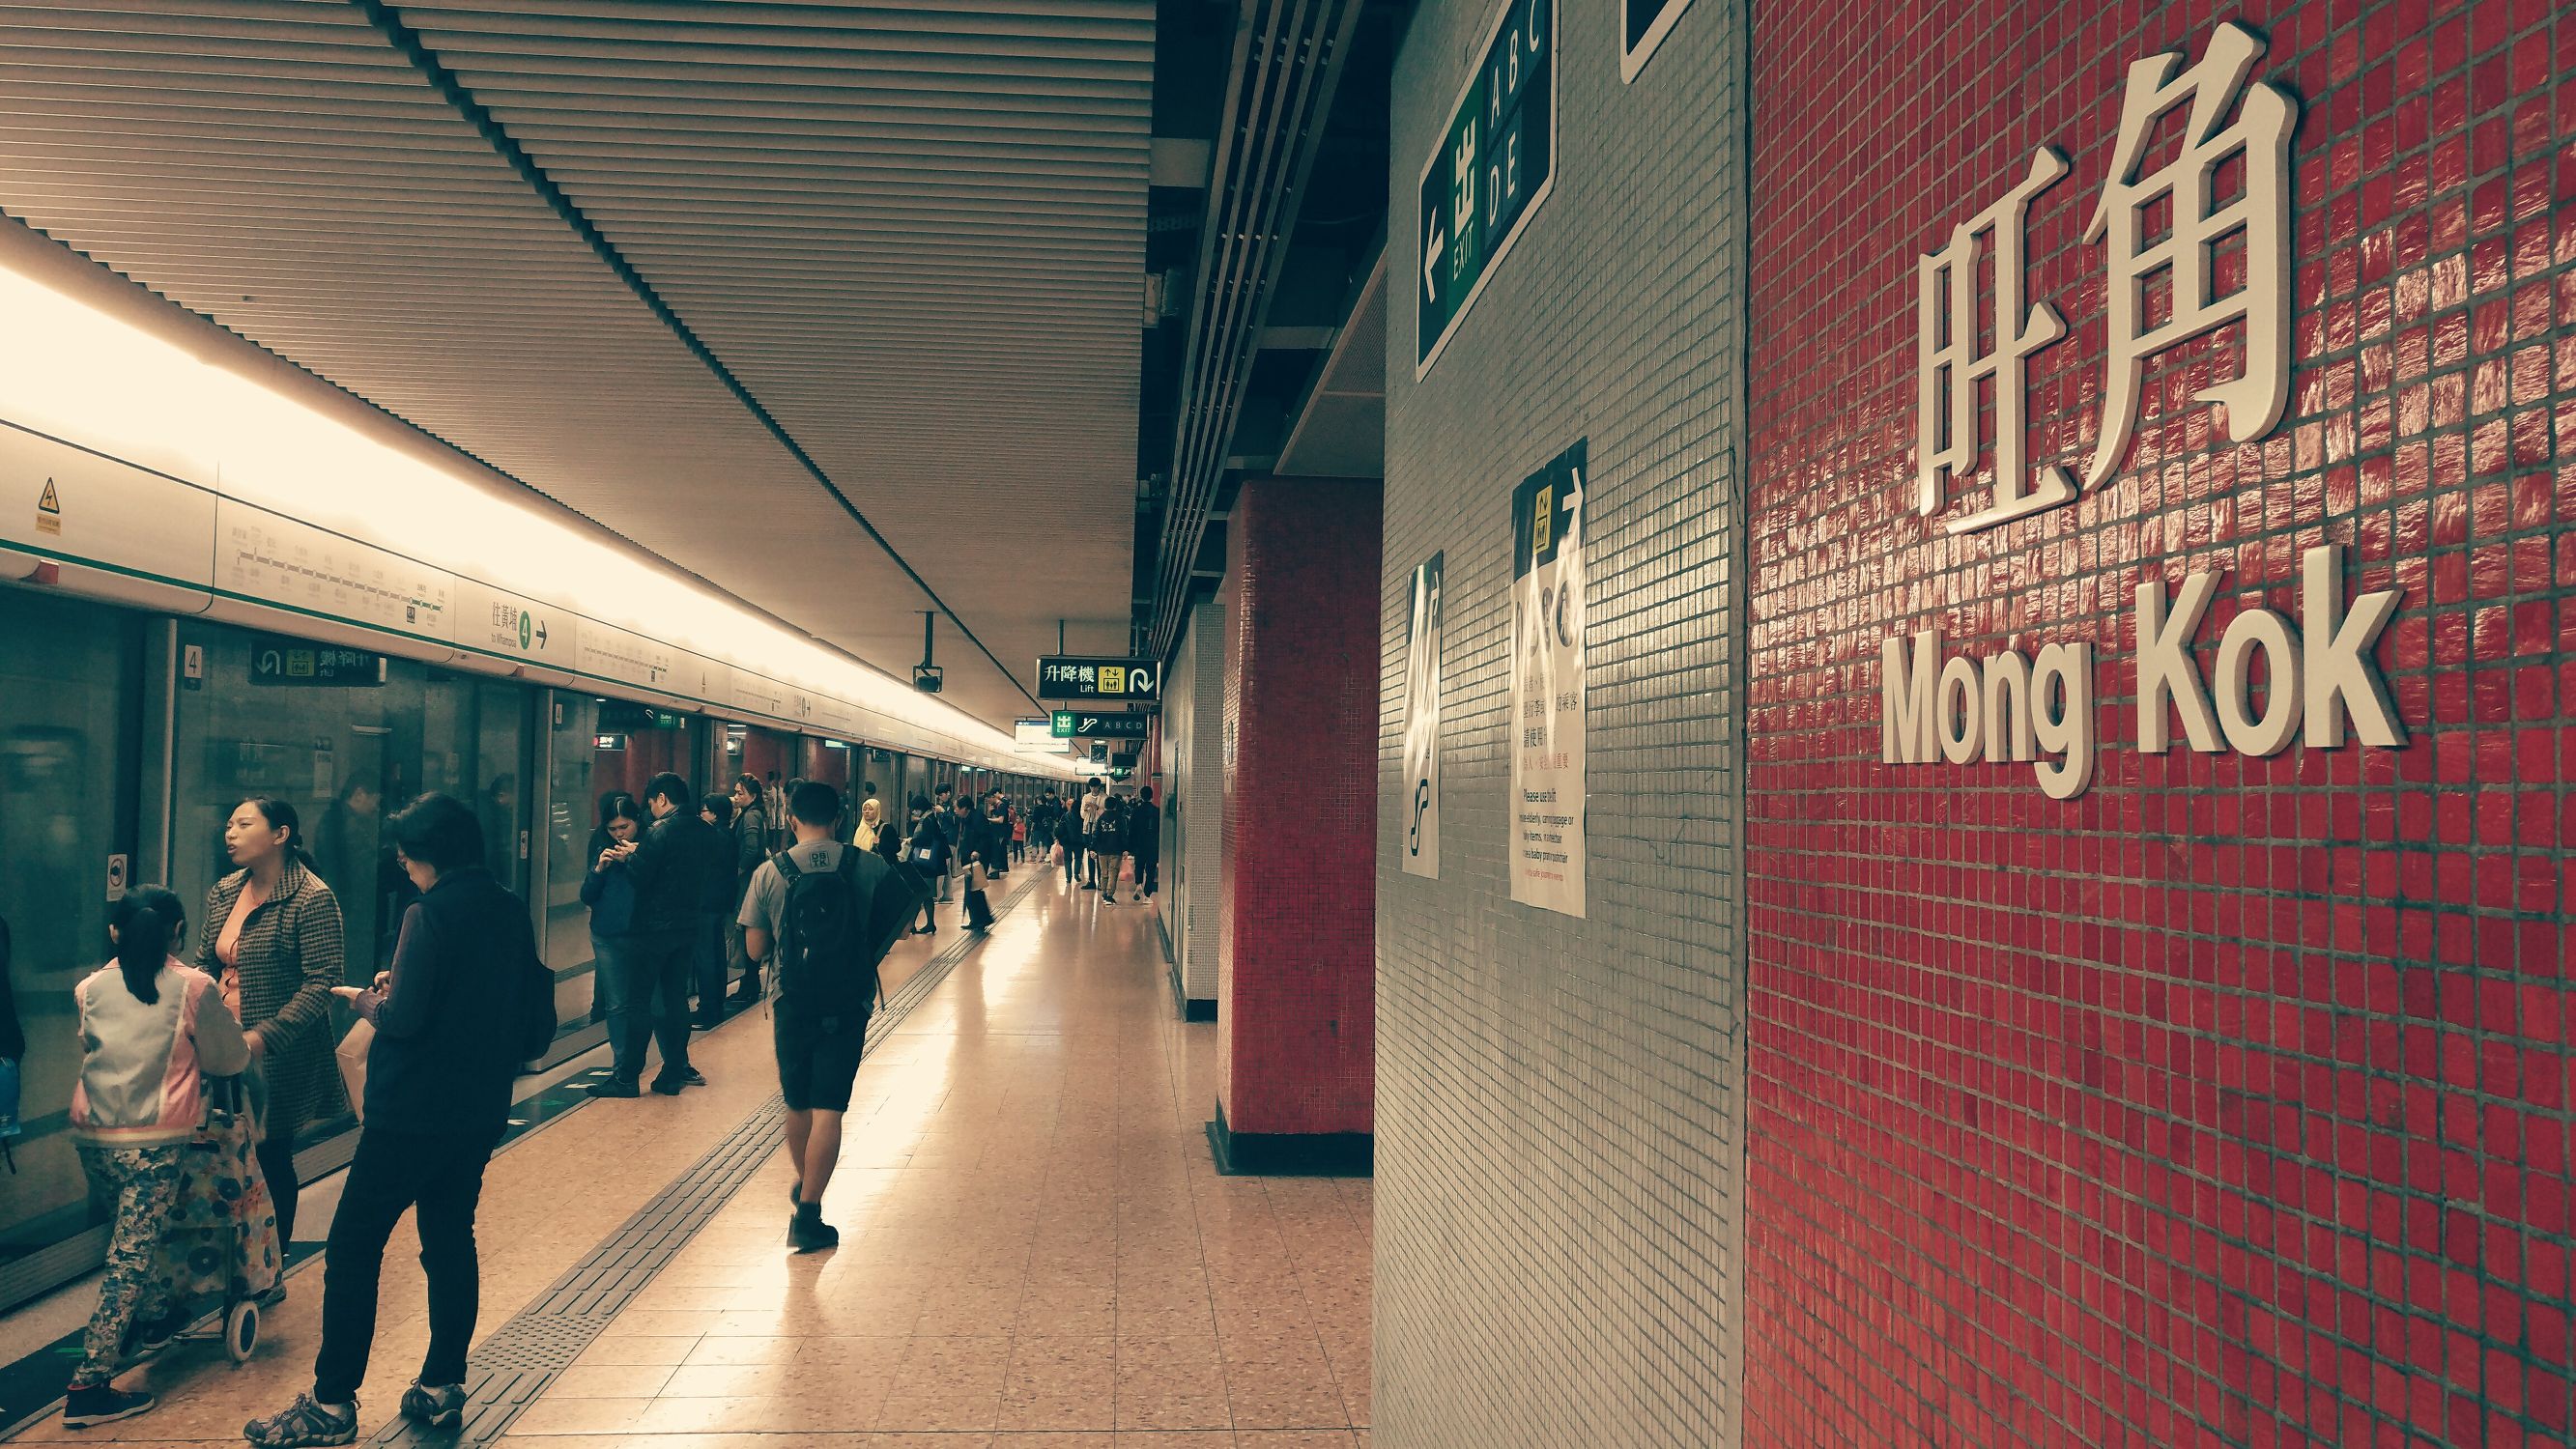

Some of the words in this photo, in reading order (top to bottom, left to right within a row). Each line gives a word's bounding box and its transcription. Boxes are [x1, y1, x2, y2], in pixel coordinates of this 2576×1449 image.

[1490, 66, 1501, 129] A
[1508, 29, 1519, 96] B
[1529, 0, 1539, 53] C
[1454, 116, 1476, 241] 出
[1489, 164, 1500, 228] D
[1507, 131, 1516, 200] E
[1453, 220, 1474, 282] EXIT
[1917, 21, 2299, 536] 旺角
[522, 618, 529, 643] 4
[188, 651, 197, 673] 4
[1044, 665, 1095, 683] 升降機
[1080, 684, 1094, 693] Lift
[1882, 629, 2094, 800] Mong
[2135, 545, 2409, 756] Kok
[1523, 788, 1539, 803] Please
